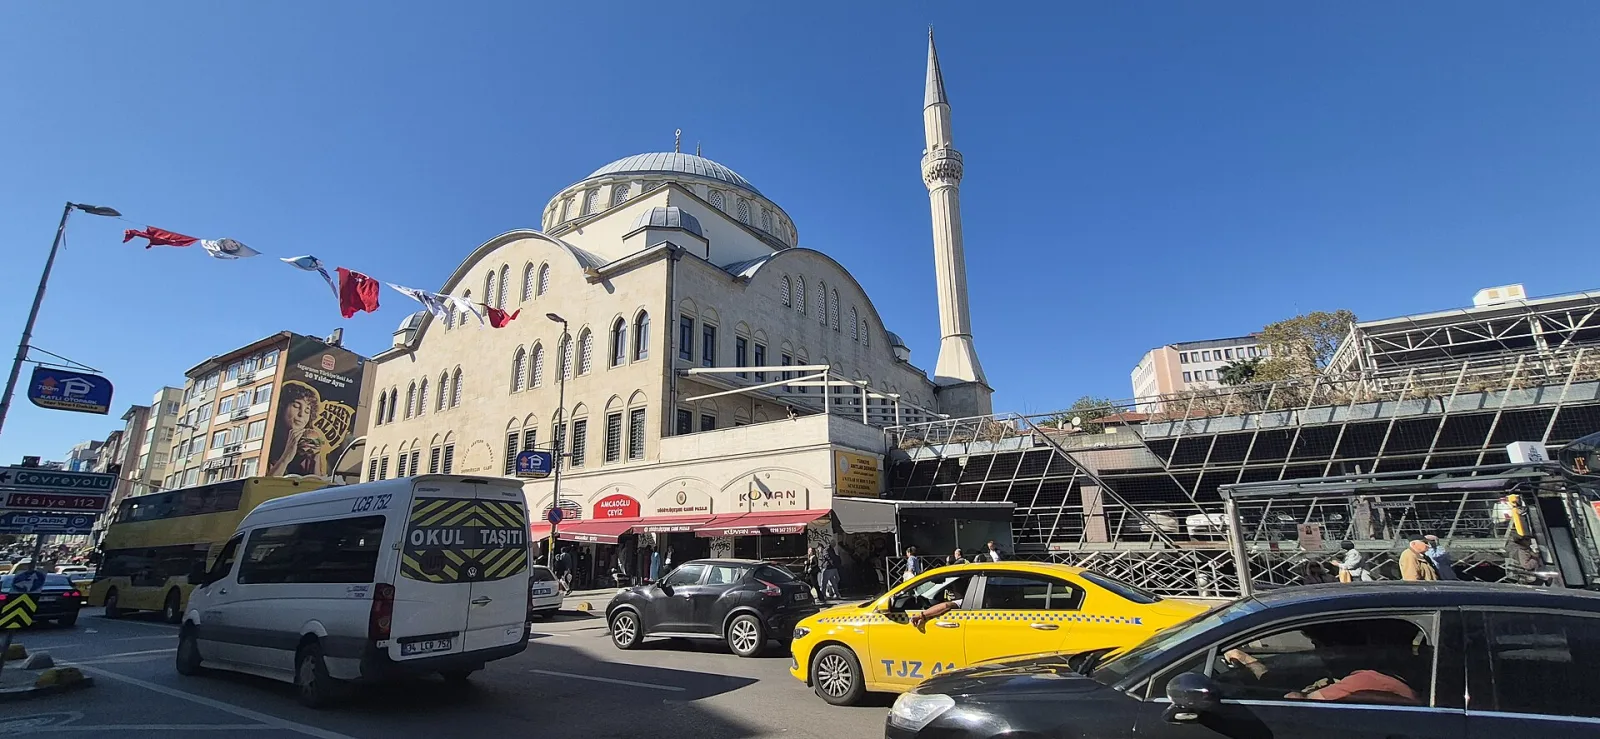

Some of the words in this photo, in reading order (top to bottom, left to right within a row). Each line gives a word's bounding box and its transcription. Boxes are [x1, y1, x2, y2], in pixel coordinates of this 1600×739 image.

[37, 384, 60, 392] 700m
[64, 396, 98, 405] OTOPARK
[324, 403, 350, 424] LEZZET
[319, 410, 348, 436] ALEV
[313, 418, 341, 447] ALDI
[739, 489, 796, 501] KOVAN
[74, 499, 95, 507] 112
[351, 495, 374, 512] LCB
[373, 493, 392, 511] 752
[600, 499, 630, 508] AMCAOĞLU
[739, 500, 796, 508] FIRIN
[607, 508, 623, 517] ÇEYİZ
[411, 529, 465, 546] OKUL
[480, 529, 523, 548] TAŞITI
[881, 659, 924, 678] TJZ
